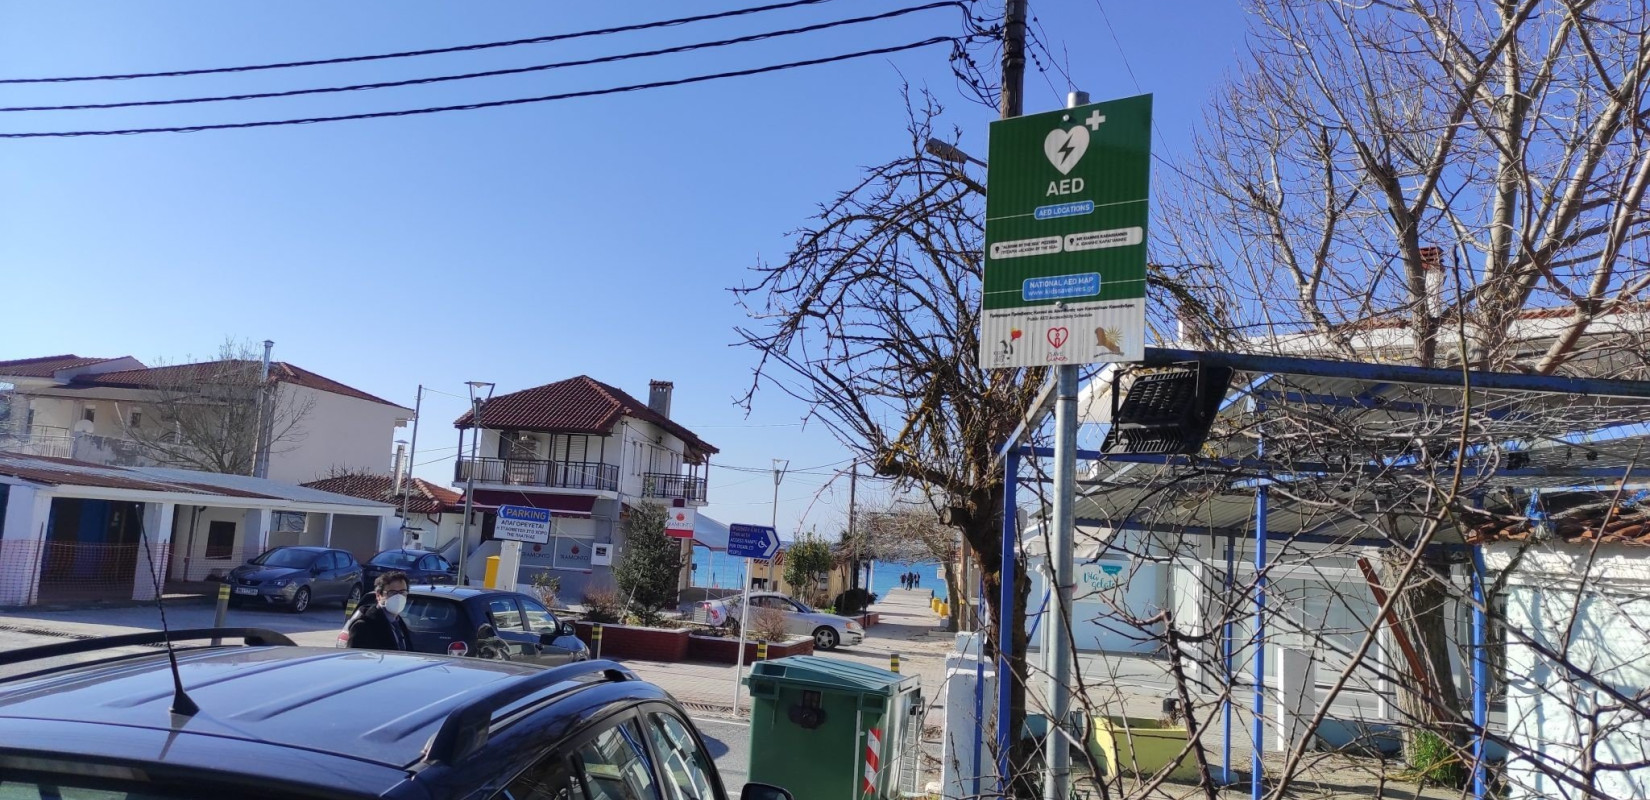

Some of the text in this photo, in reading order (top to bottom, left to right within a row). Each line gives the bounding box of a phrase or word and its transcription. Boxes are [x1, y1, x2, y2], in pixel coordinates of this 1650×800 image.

[1046, 178, 1084, 196] AED
[1038, 204, 1090, 217] AED LOCATIONS
[1029, 280, 1063, 289] NATIONAL
[1063, 278, 1077, 286] AED
[507, 508, 546, 520] PARKING
[501, 520, 545, 529] ΑΠΑΓΟΡΕΥΕΤΑΙ
